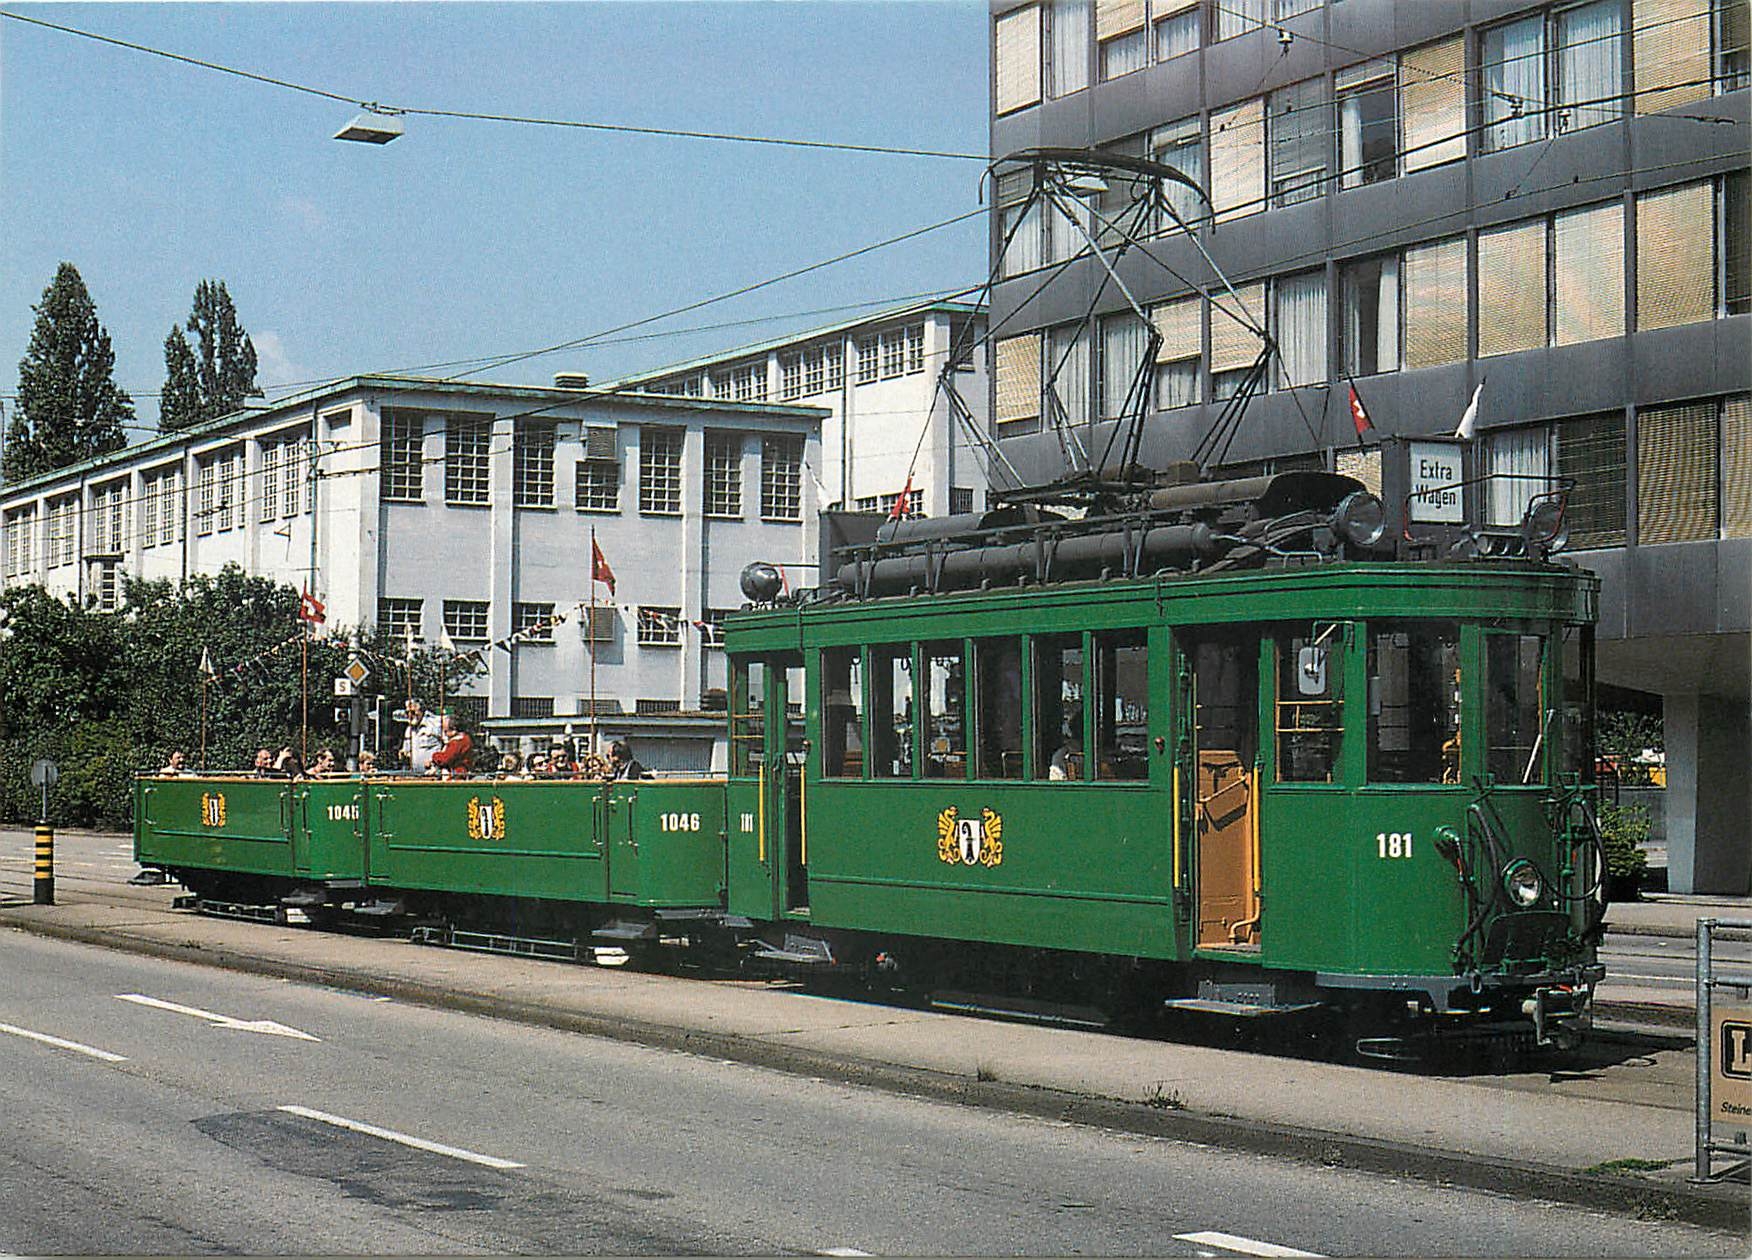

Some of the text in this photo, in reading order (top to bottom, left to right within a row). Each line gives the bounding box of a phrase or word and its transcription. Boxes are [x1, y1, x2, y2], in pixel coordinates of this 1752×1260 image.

[1420, 459, 1452, 480] Extra
[1415, 484, 1456, 509] Wagen
[339, 681, 346, 693] S
[660, 813, 700, 832] 1046
[1376, 833, 1413, 858] 181
